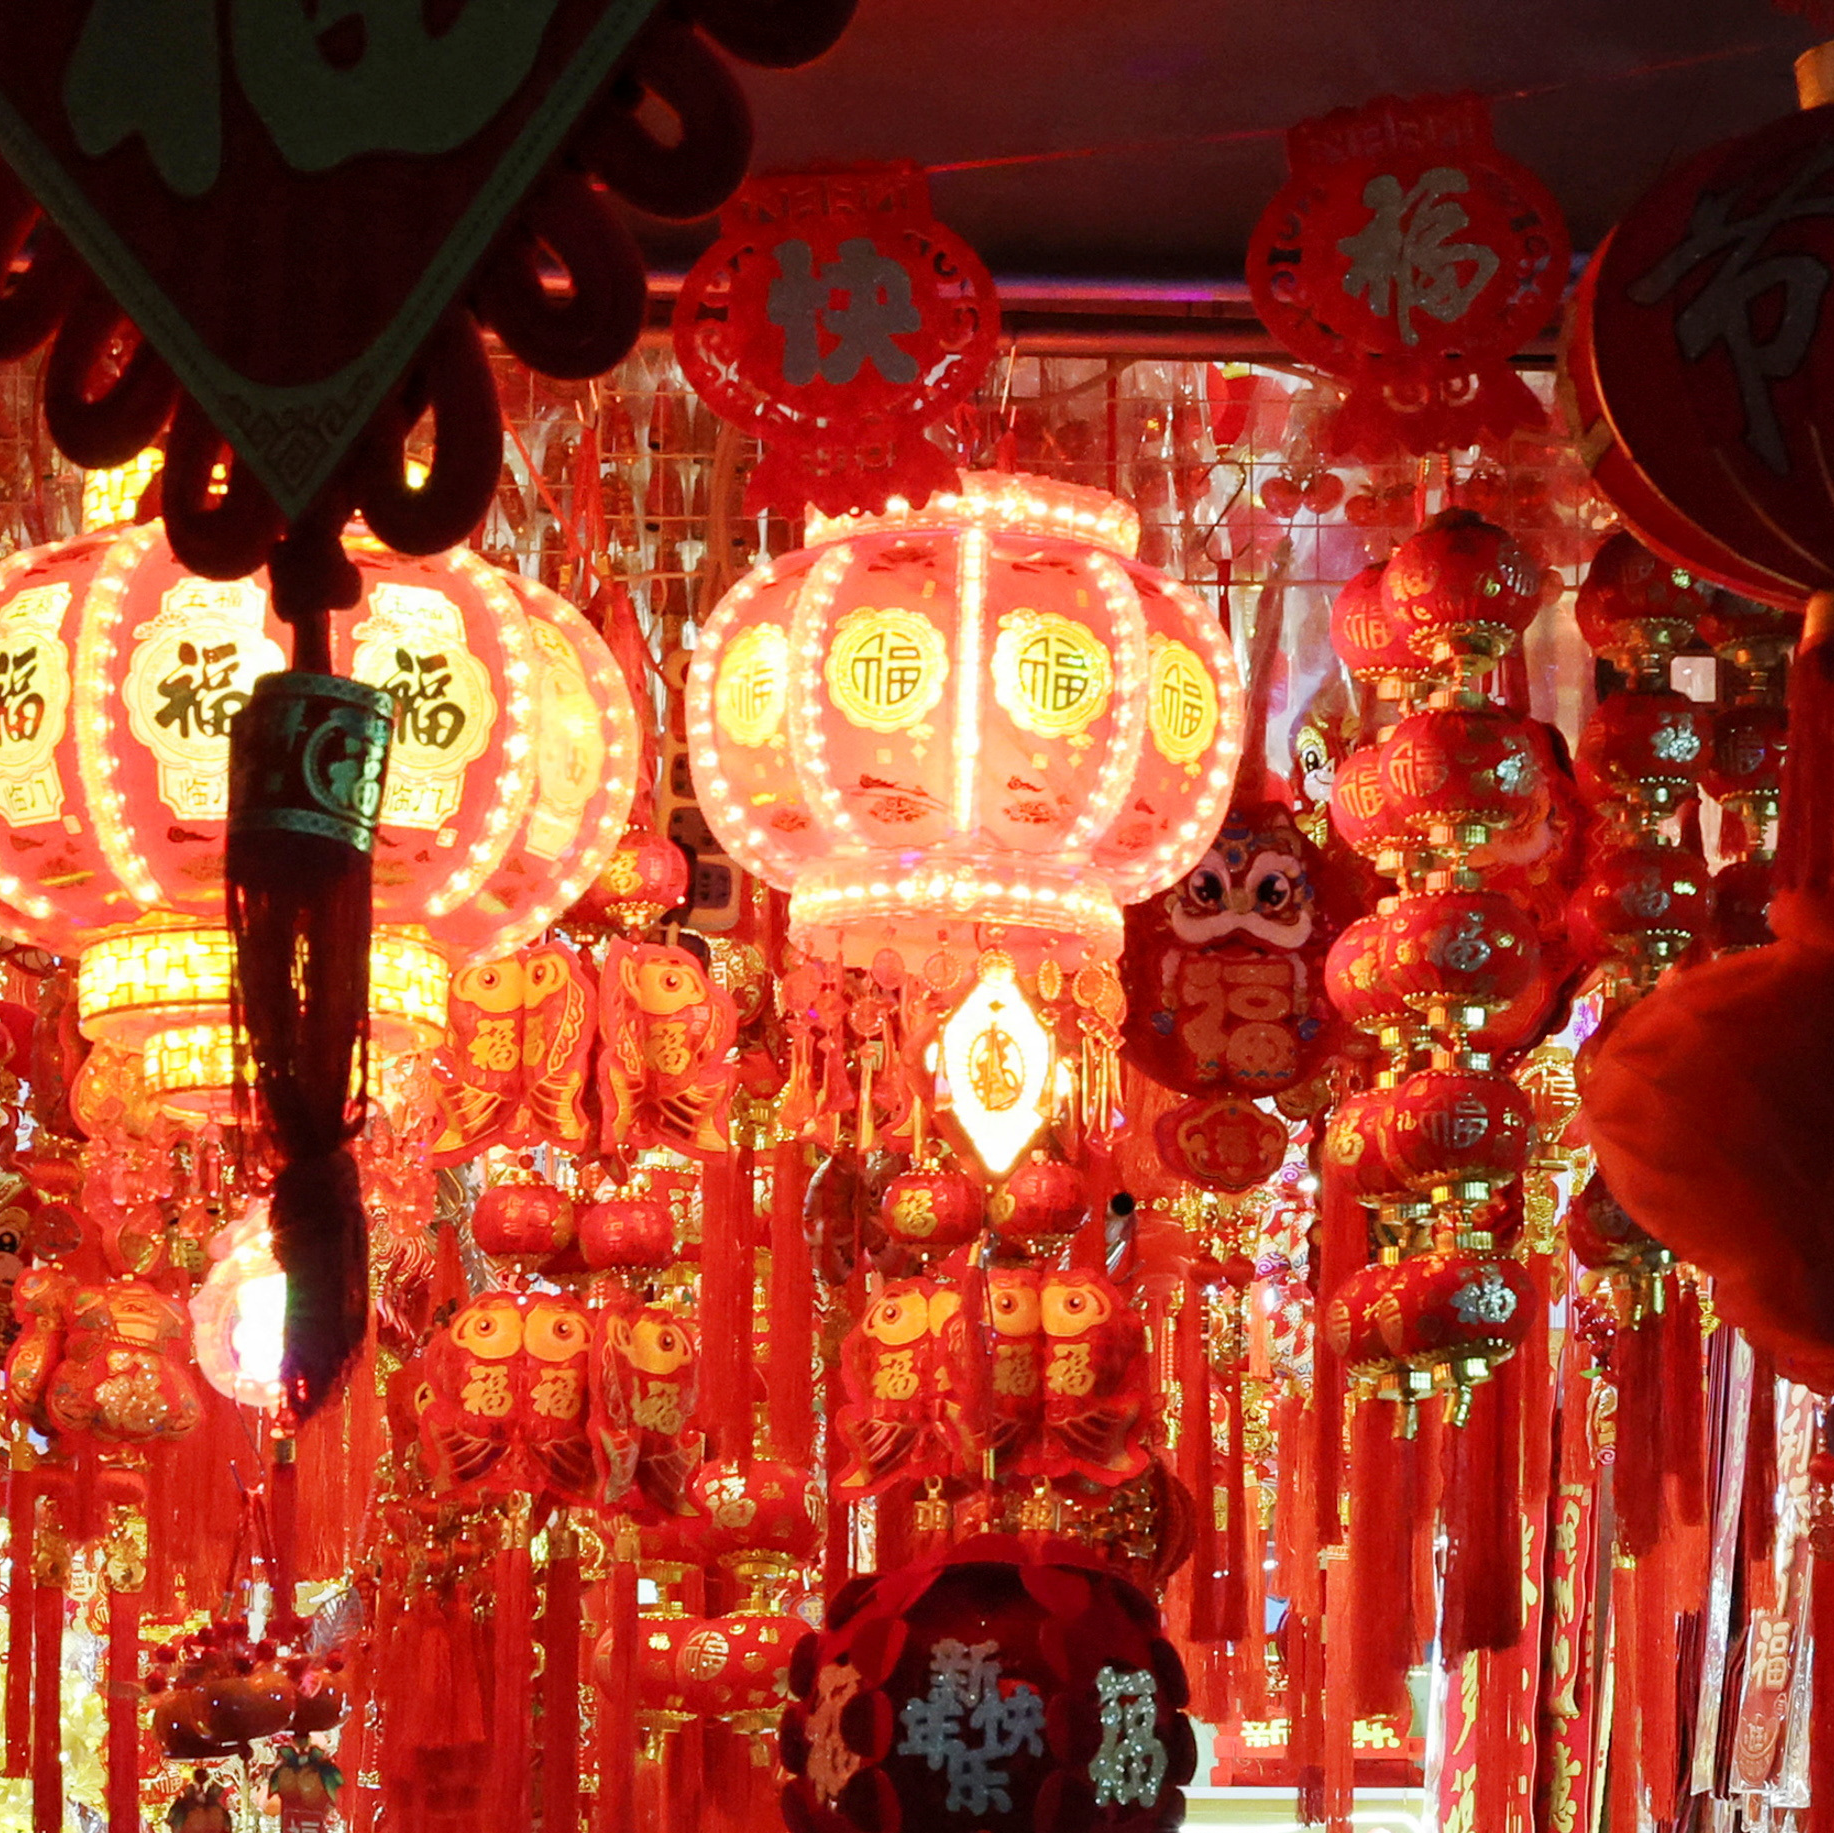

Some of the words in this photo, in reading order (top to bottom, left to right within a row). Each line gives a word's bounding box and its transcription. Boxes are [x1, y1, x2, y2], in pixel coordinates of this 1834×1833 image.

[1336, 166, 1501, 345] 福
[768, 236, 920, 387] 快
[1343, 611, 1394, 651] 福
[155, 641, 251, 740] 福
[850, 630, 922, 707] 福
[1018, 633, 1091, 712] 福
[381, 648, 466, 751] 福
[1161, 661, 1204, 740] 福
[1338, 765, 1384, 819] 福
[1387, 741, 1448, 800] 福
[470, 1017, 521, 1073] 福
[647, 1020, 693, 1077] 福
[1419, 1101, 1489, 1150] 福
[893, 1188, 937, 1237] 福
[461, 1366, 514, 1418] 福
[529, 1368, 581, 1419] 福
[872, 1347, 919, 1401] 福
[992, 1343, 1039, 1396] 福
[1048, 1342, 1097, 1397] 福
[631, 1380, 683, 1436] 福
[683, 1632, 730, 1681] 福
[1752, 1618, 1791, 1690] 福
[897, 1637, 1047, 1815] 新年快乐
